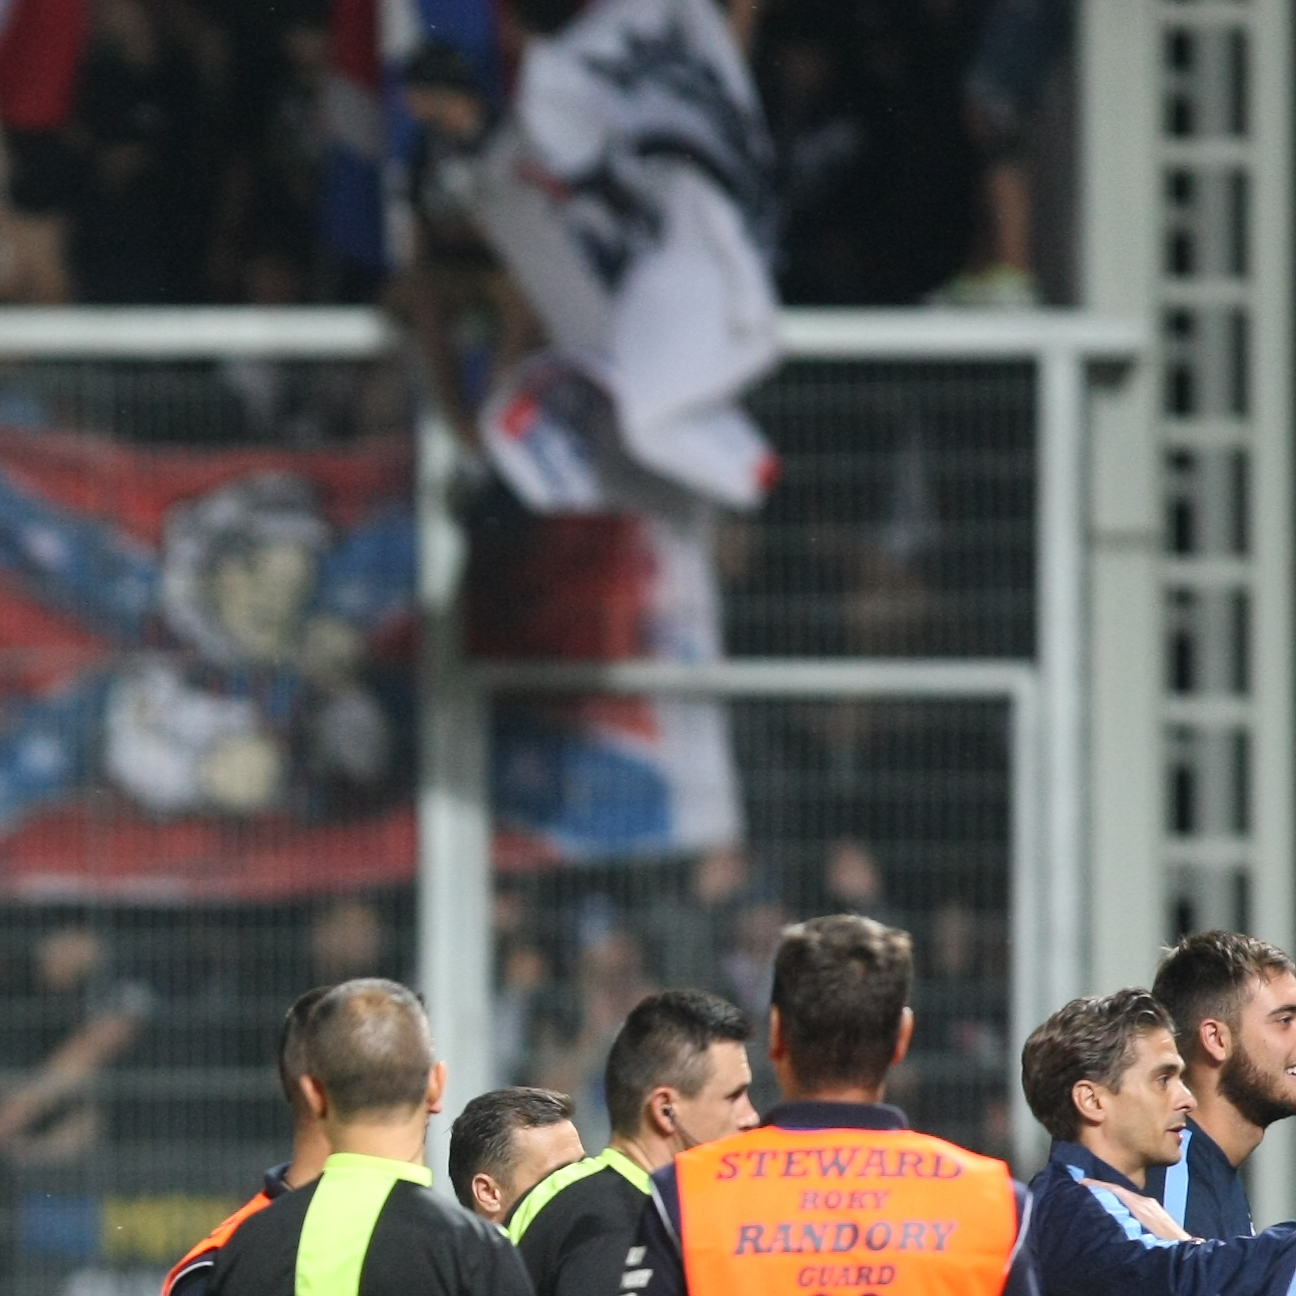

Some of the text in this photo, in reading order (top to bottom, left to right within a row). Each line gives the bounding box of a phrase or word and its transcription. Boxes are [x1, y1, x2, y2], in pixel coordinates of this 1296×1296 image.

[716, 1146, 962, 1181] STEWARD
[734, 1220, 957, 1255] RANDORY
[798, 1265, 896, 1287] GUARD
